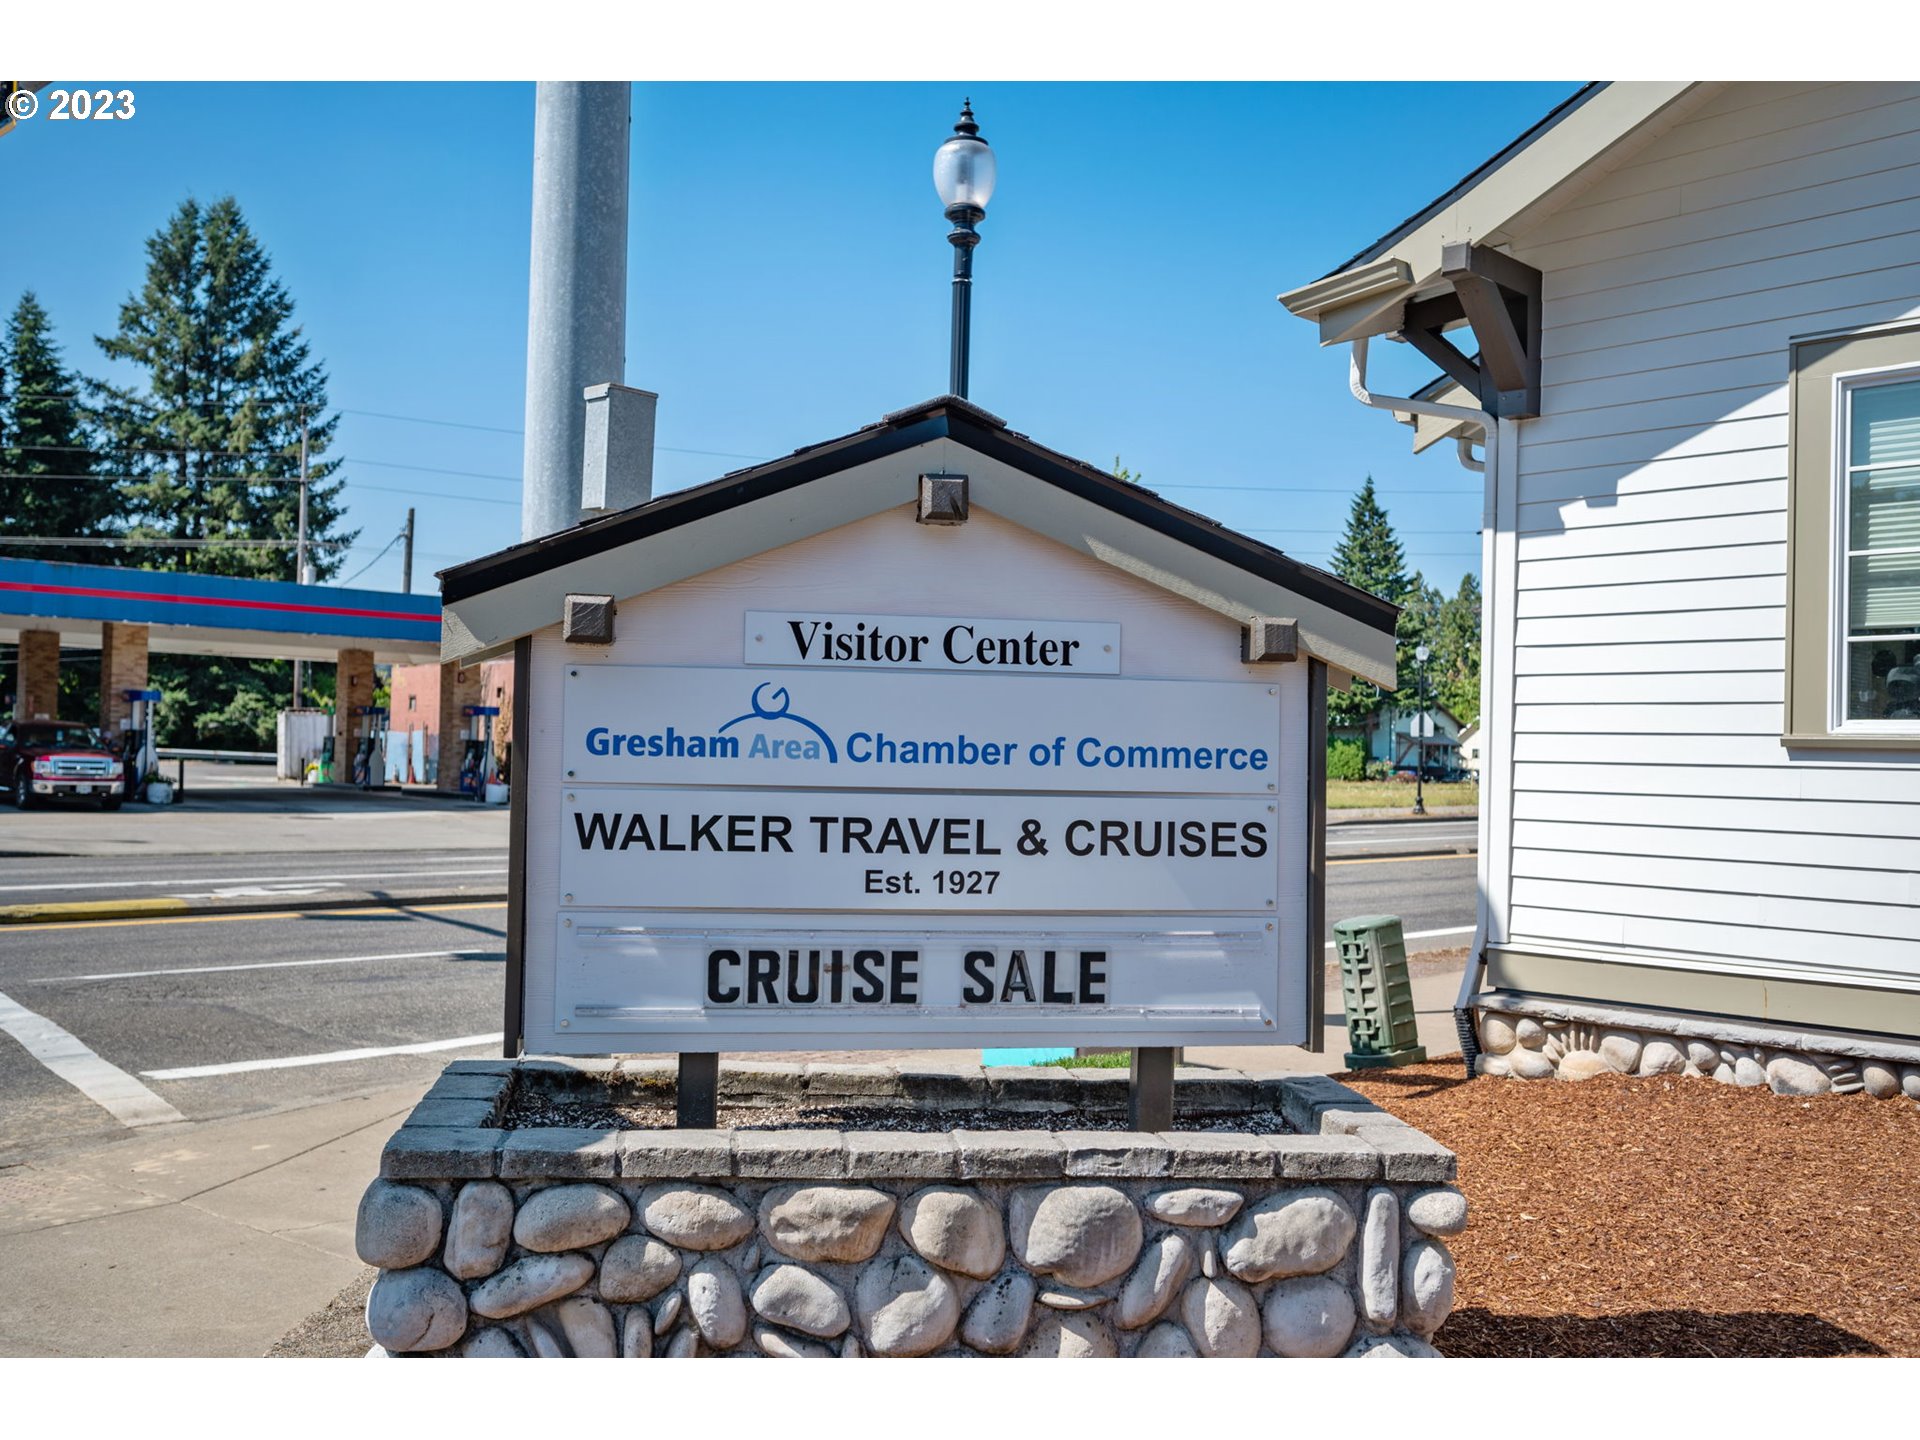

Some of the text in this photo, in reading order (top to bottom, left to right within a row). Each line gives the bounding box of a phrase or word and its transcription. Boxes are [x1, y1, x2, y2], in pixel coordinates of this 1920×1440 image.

[788, 621, 1078, 666] Visitor Center
[585, 726, 1268, 770] Gresham Area Chamber of Commerce
[574, 813, 1267, 858] WALKER TRAVEL & CRUISES
[864, 870, 1000, 894] Est. 1927
[706, 949, 1107, 1004] CRUISE SALE
